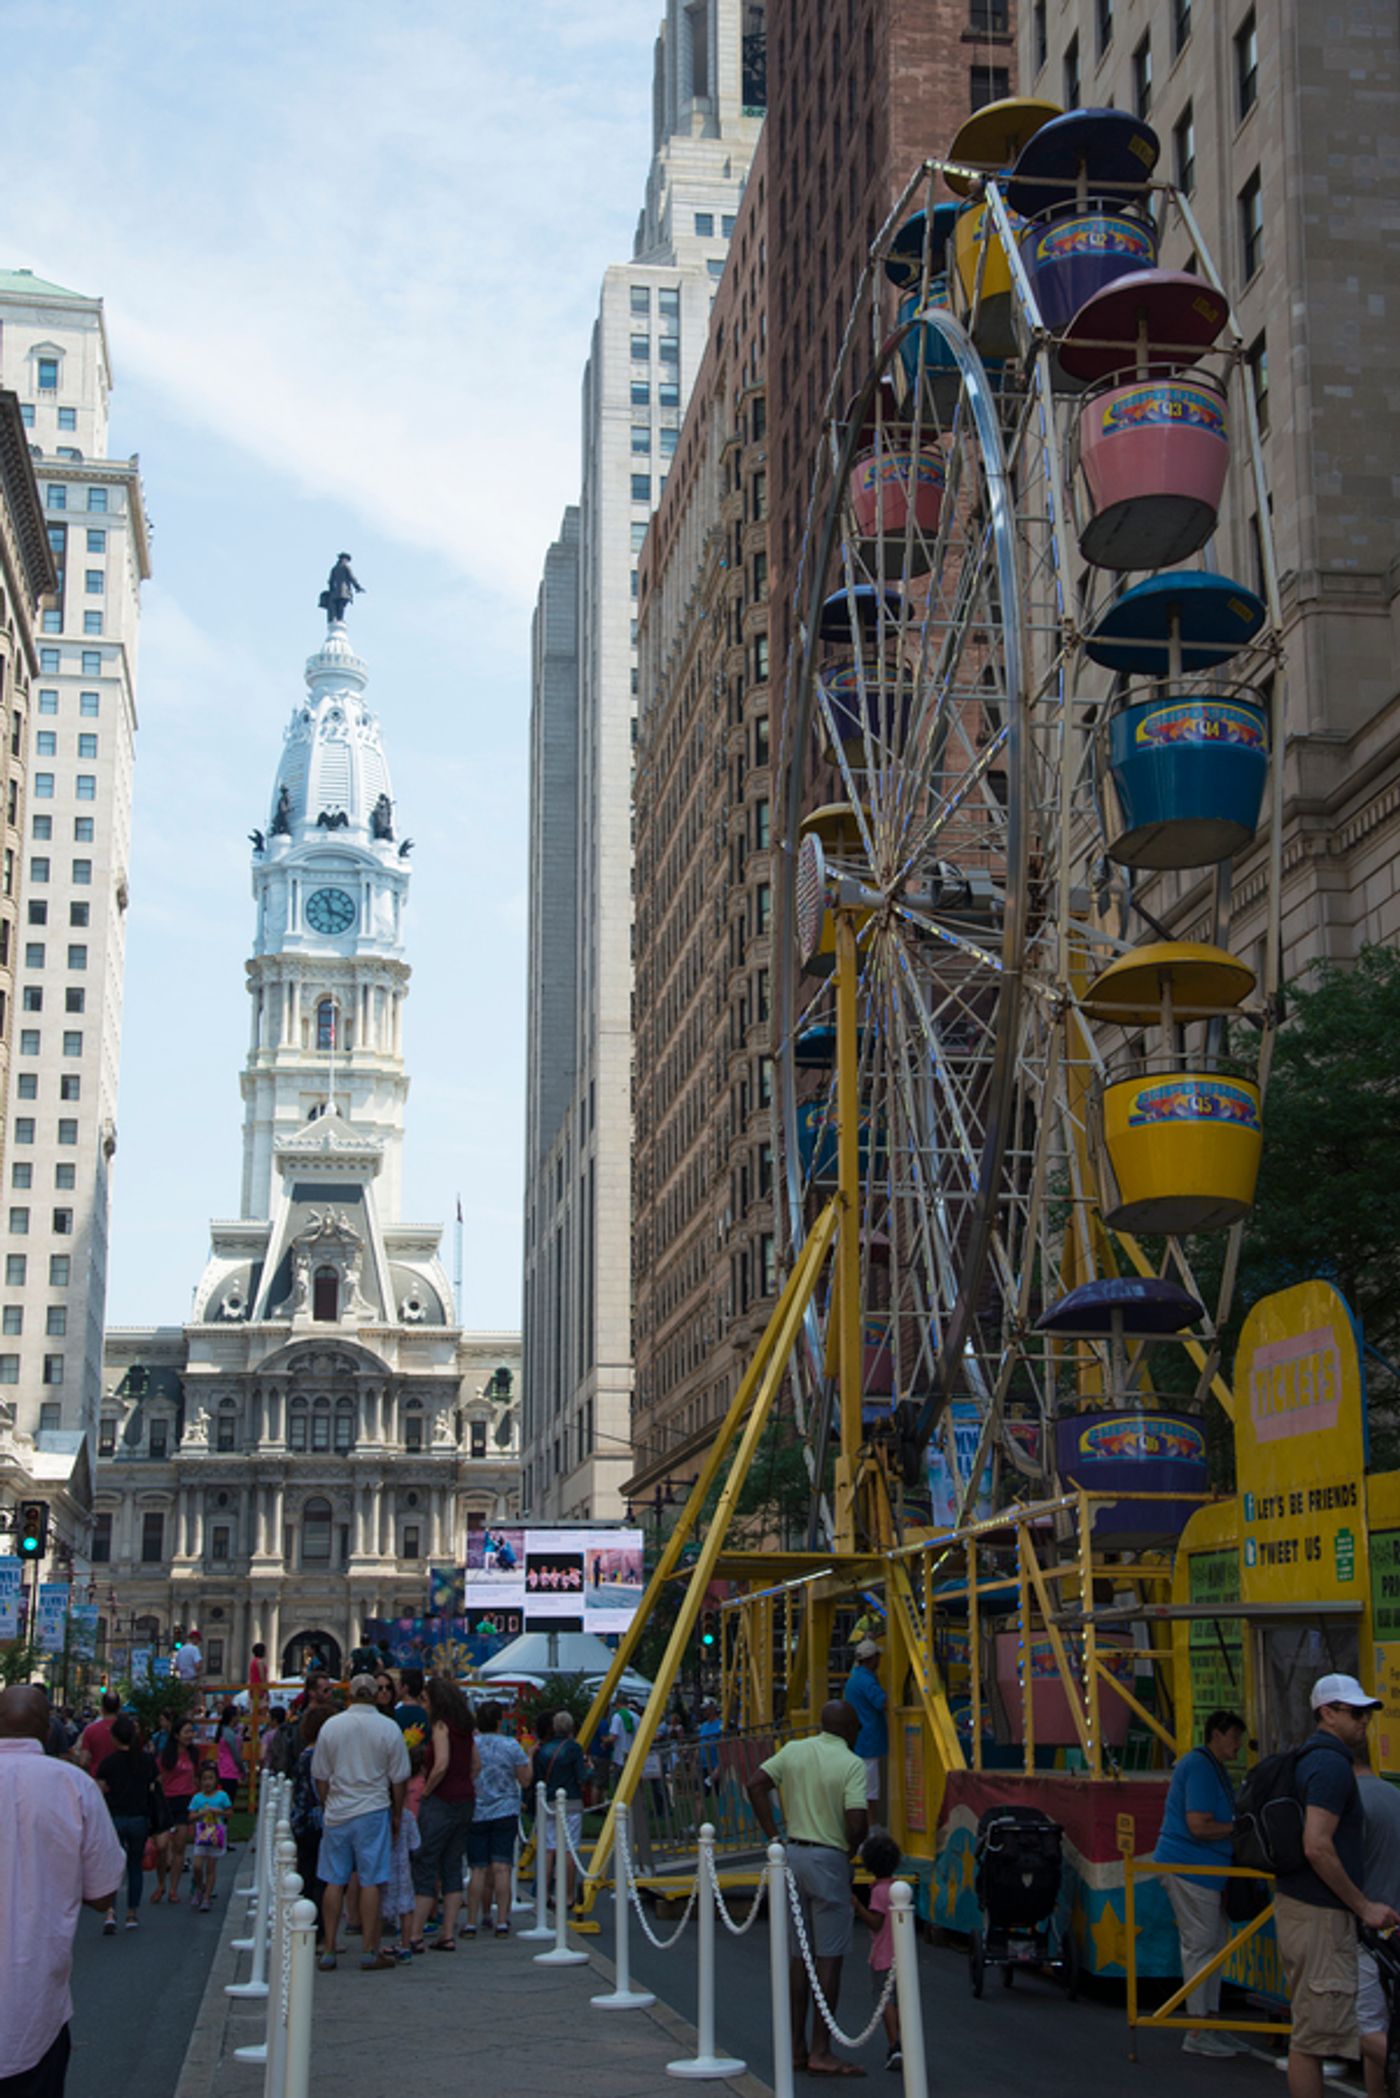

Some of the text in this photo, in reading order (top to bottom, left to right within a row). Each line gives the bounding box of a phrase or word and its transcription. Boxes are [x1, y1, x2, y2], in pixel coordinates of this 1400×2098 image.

[1255, 1347, 1337, 1420] TICKETS
[1257, 1496, 1285, 1520] LET'S
[1290, 1494, 1303, 1516] BE
[1309, 1483, 1357, 1512] FRIENDS
[1260, 1539, 1299, 1566] TWEET
[1304, 1536, 1322, 1561] US
